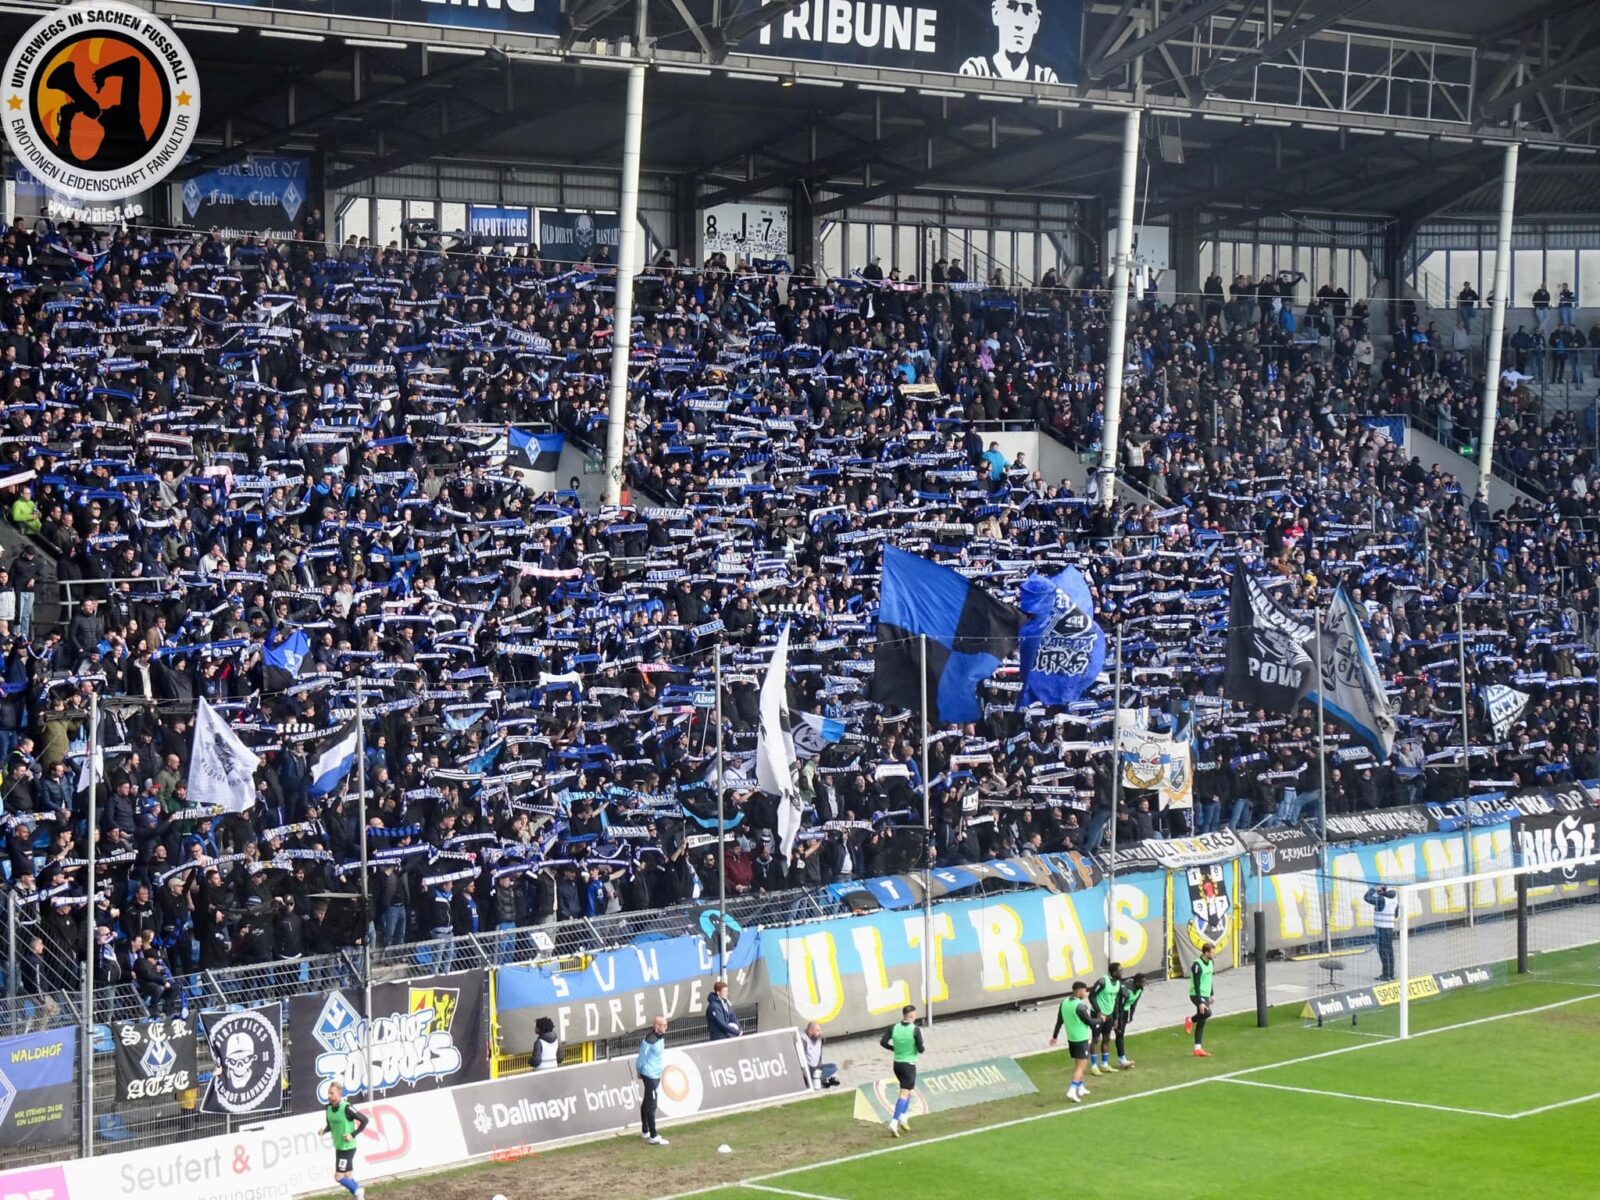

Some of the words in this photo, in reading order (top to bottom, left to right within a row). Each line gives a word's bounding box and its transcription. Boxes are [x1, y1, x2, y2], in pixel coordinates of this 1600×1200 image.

[207, 188, 235, 206] Fan
[248, 191, 278, 206] Club
[472, 217, 528, 238] KAPUTTICKS
[541, 227, 555, 245] OLD
[555, 225, 574, 244] DIRTY
[706, 215, 717, 239] 8
[762, 218, 773, 241] 7
[779, 882, 1150, 1024] ULTRAS
[1440, 973, 1464, 990] bwin
[1465, 967, 1489, 984] bwin
[557, 976, 724, 1042] FOREVE
[1317, 997, 1344, 1016] bwin
[1346, 991, 1372, 1010] bwin
[242, 1019, 268, 1042] DICKS
[11, 1042, 63, 1064] WALDHOF
[492, 1094, 577, 1129] Dallmayr
[584, 1080, 644, 1113] bringt
[709, 1064, 738, 1088] ins
[741, 1053, 788, 1083] Büro!
[923, 1064, 1007, 1096] EICHBAUM
[121, 1151, 222, 1194] Seufert
[232, 1144, 250, 1175] &
